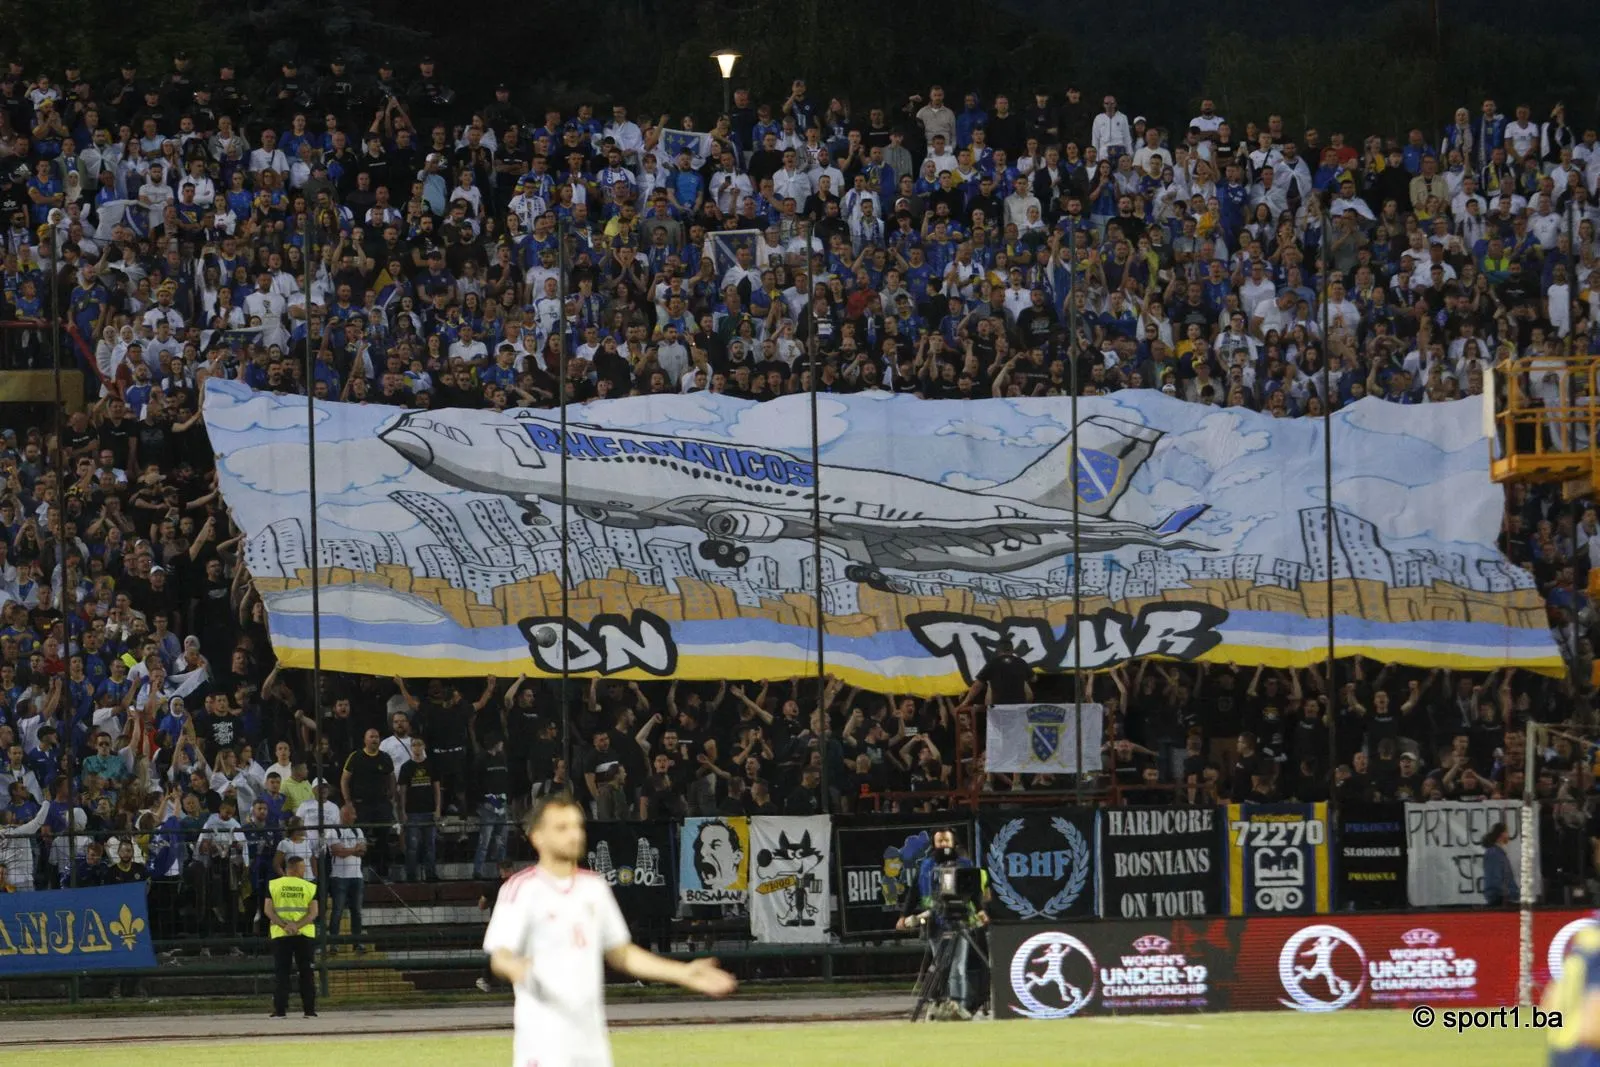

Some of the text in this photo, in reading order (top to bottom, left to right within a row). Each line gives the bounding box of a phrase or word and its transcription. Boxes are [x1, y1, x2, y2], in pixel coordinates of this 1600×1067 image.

[519, 601, 1226, 687] ON TOUR
[1108, 809, 1213, 836] HARDCORE
[1232, 820, 1323, 846] 72270
[1005, 850, 1073, 880] BHF
[1114, 848, 1211, 877] BOSNIANS
[1120, 890, 1206, 919] ON TOUR
[1120, 954, 1186, 967] WOMEN'S
[1388, 947, 1455, 960] WOMEN'S
[1100, 965, 1207, 985] UNDER-19
[1368, 958, 1476, 978] UNDER-19
[1102, 983, 1207, 997] CHAMPIONSHIP
[1370, 977, 1476, 991] CHAMPIONSHIP
